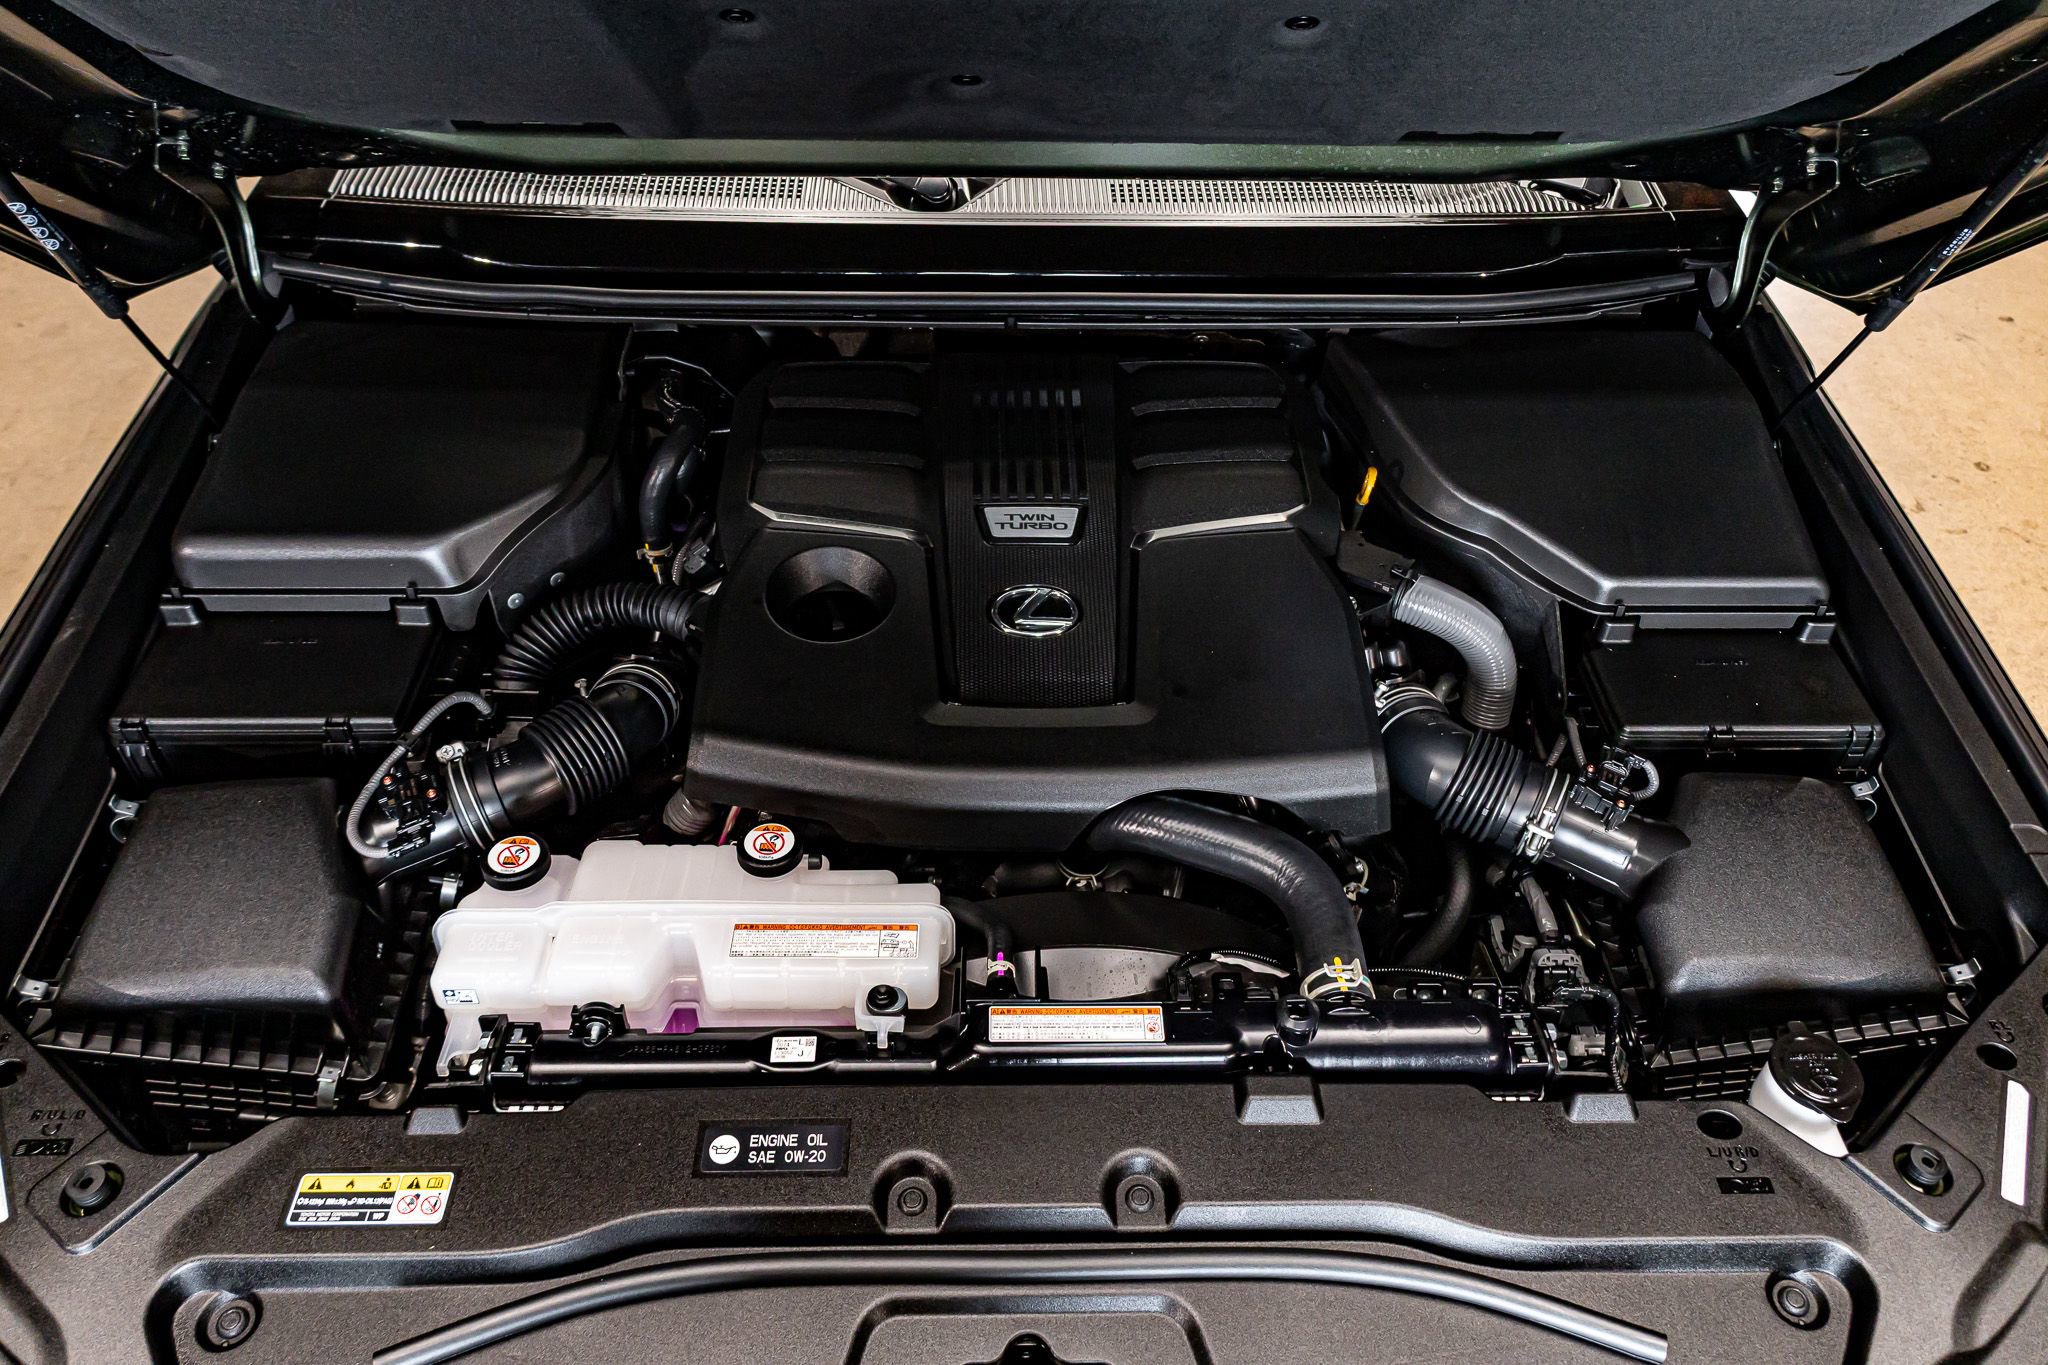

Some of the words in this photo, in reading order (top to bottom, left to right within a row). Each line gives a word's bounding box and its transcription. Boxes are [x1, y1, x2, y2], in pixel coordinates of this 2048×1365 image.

[994, 522, 1068, 530] TURBO
[749, 1134, 799, 1147] ENGINE
[807, 1134, 828, 1146] OIL
[747, 1150, 776, 1164] SAE
[784, 1150, 826, 1163] 0W-20
